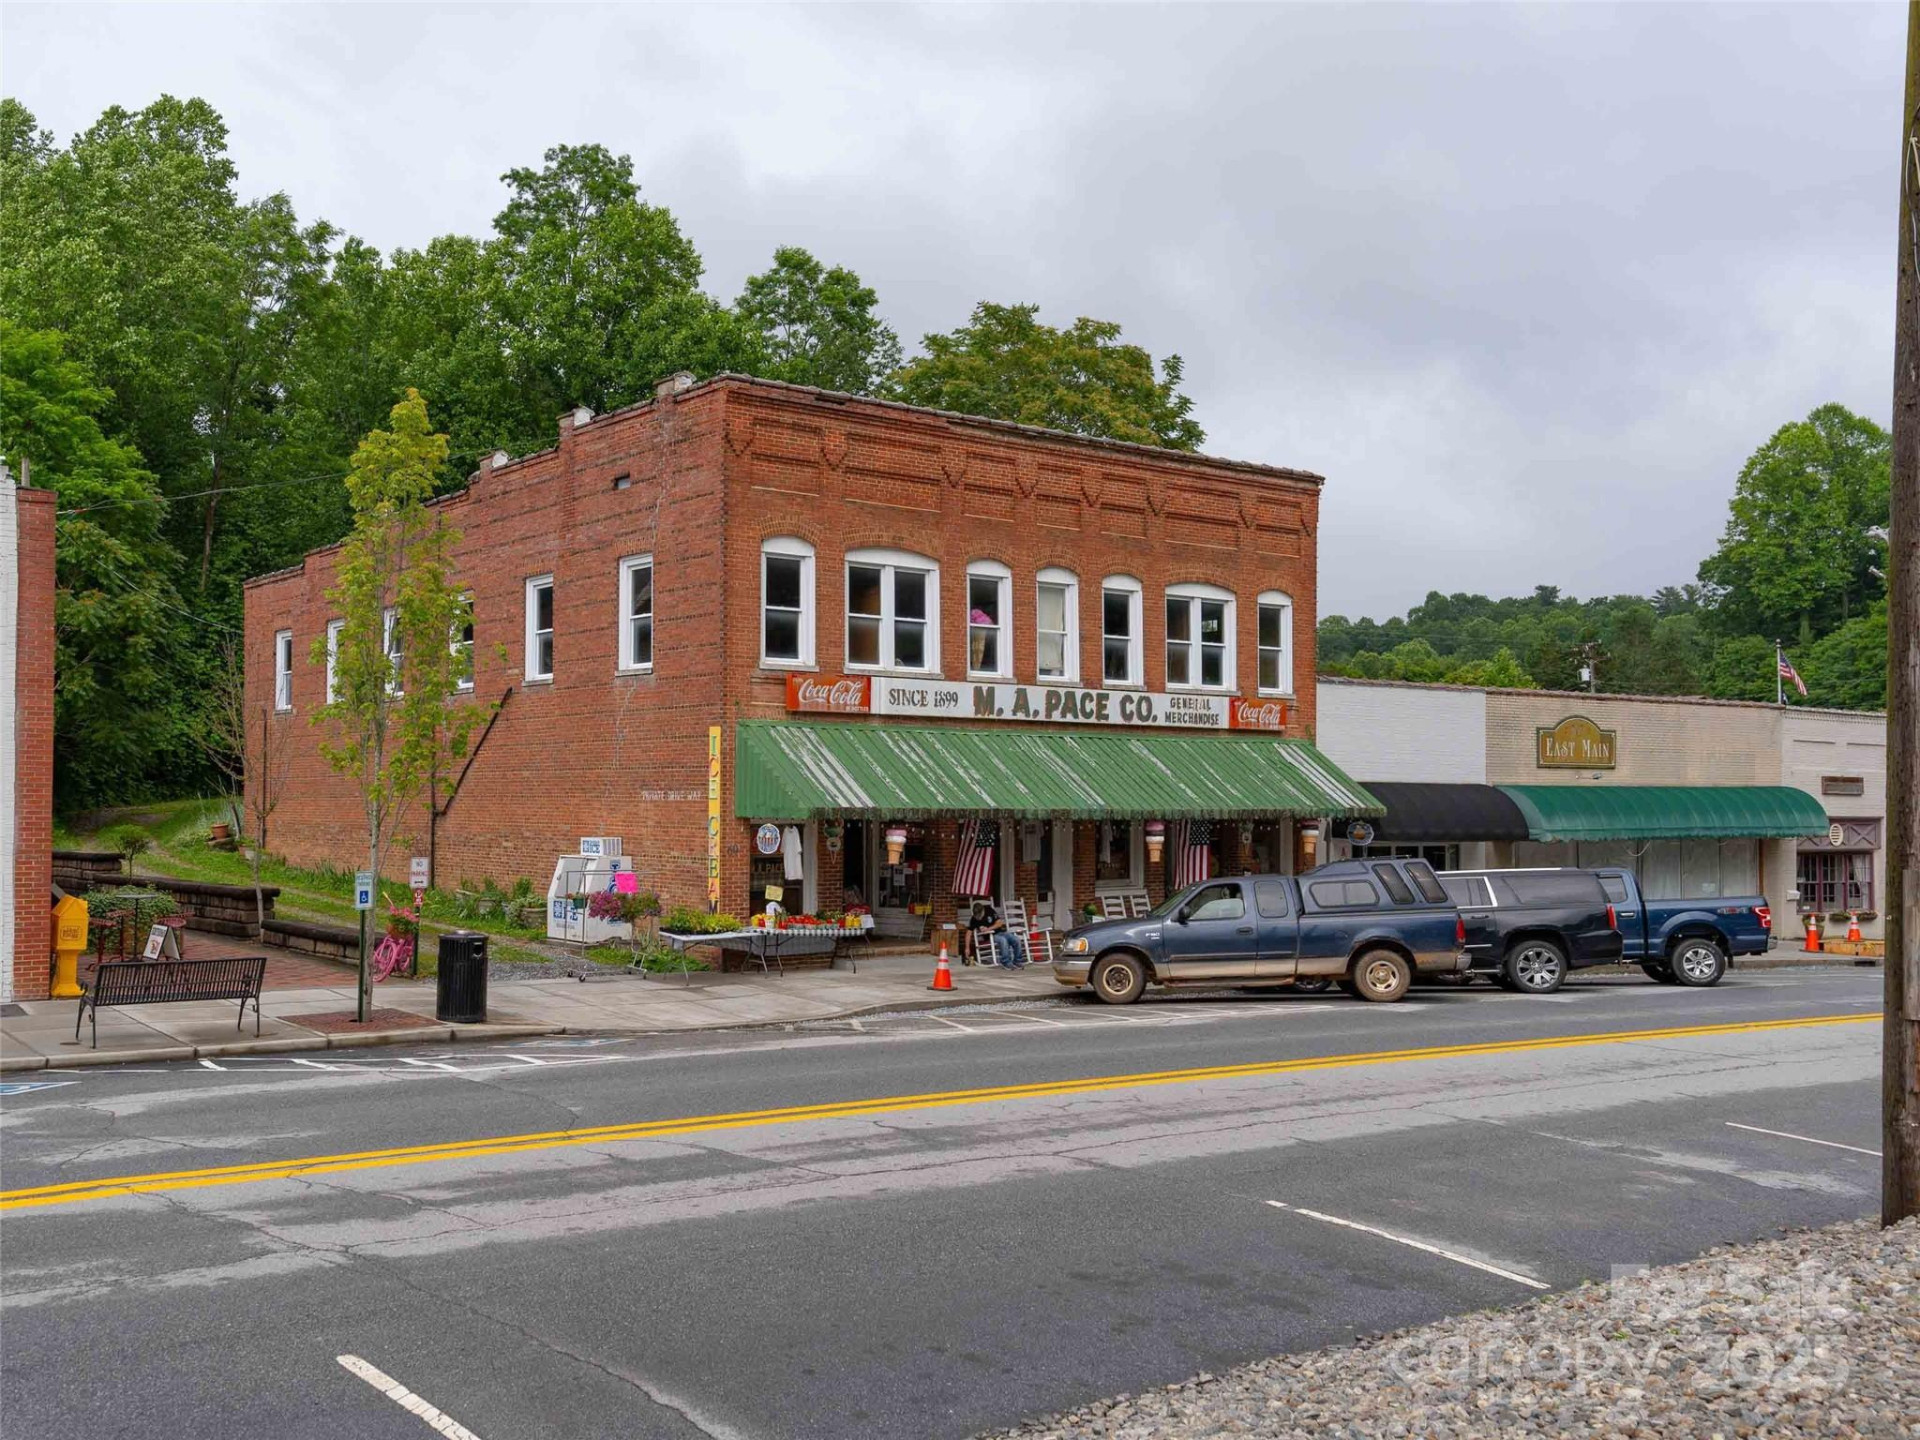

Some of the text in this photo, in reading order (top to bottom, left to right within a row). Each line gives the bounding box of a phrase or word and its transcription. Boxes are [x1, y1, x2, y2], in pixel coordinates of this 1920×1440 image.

[798, 678, 863, 705] Coca-Cola
[889, 688, 959, 709] SINCE 1899
[1044, 689, 1110, 722] PACE
[1119, 694, 1159, 723] CO.
[1169, 696, 1212, 712] GENERAL
[1237, 702, 1283, 724] Coca-Cola
[1164, 710, 1220, 726] MERCHANDISE
[708, 735, 720, 800] ICE
